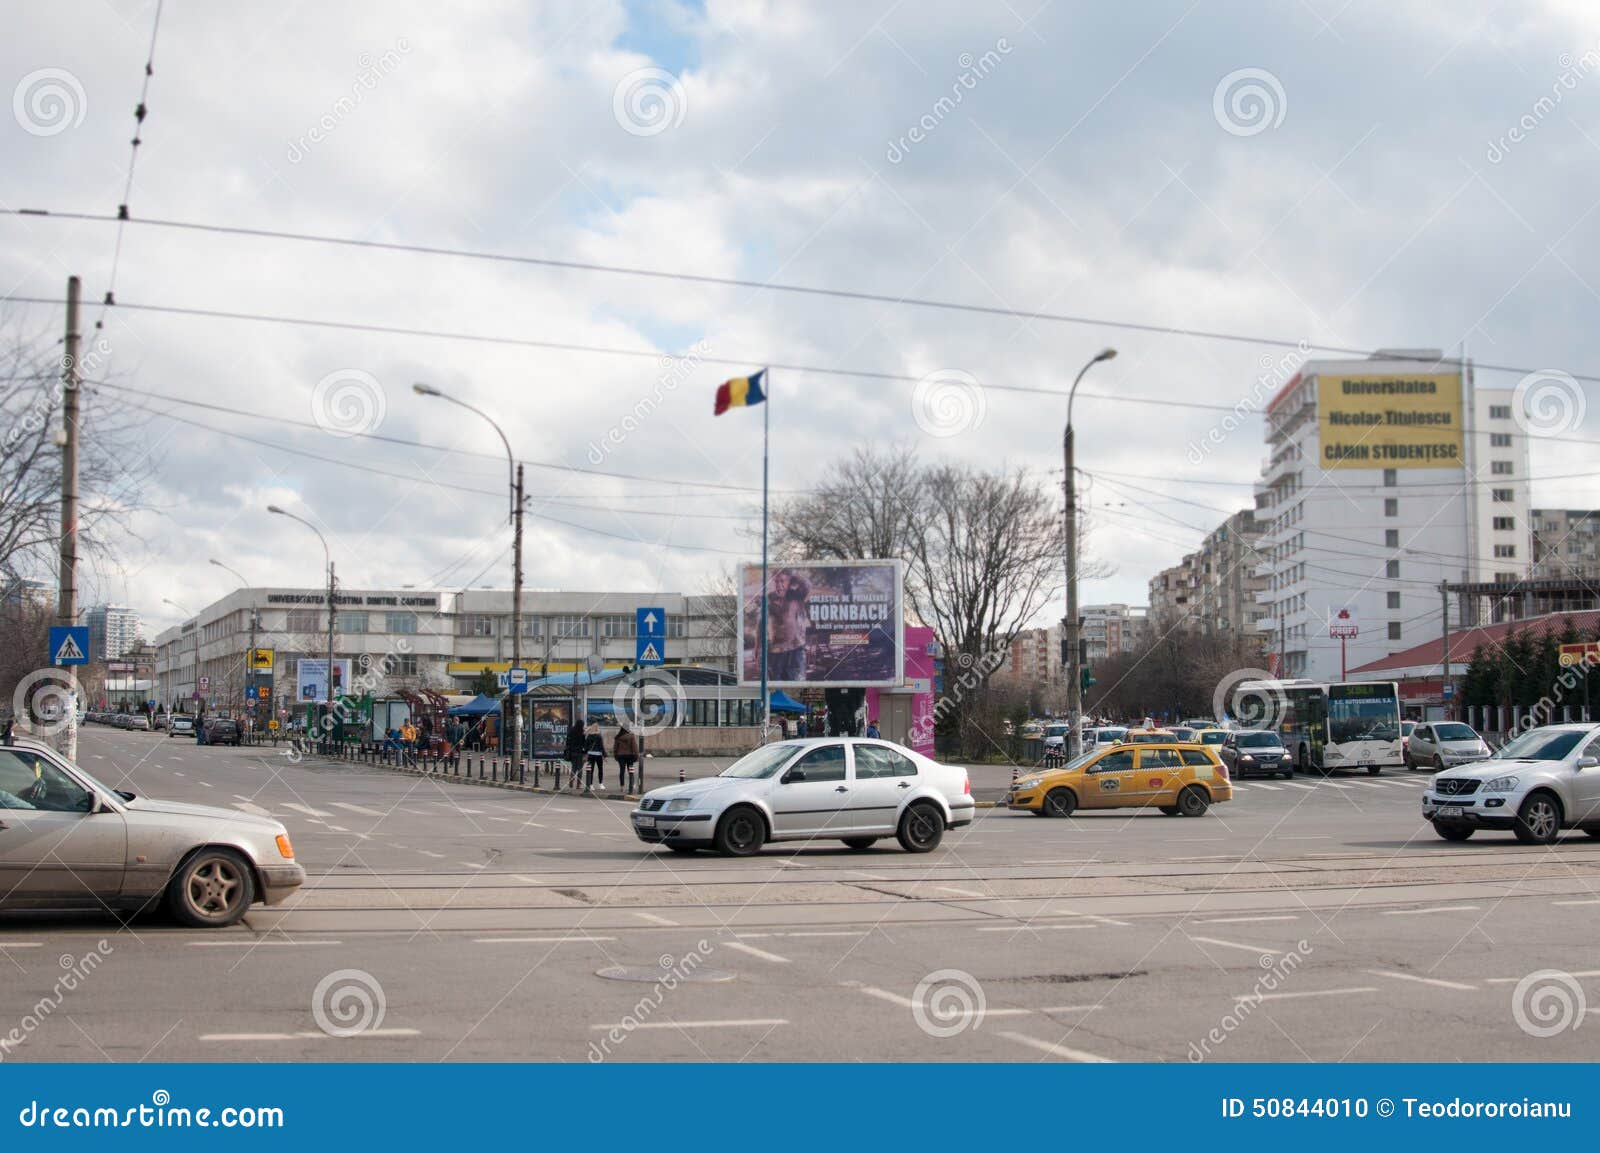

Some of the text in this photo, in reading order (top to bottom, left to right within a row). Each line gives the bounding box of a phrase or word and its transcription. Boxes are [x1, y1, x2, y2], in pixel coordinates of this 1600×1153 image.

[1342, 380, 1436, 394] Universitatea
[1329, 411, 1451, 425] Nicolae Titulescu
[267, 594, 325, 604] UNIVERSITATEA
[810, 604, 888, 620] HORNBACH
